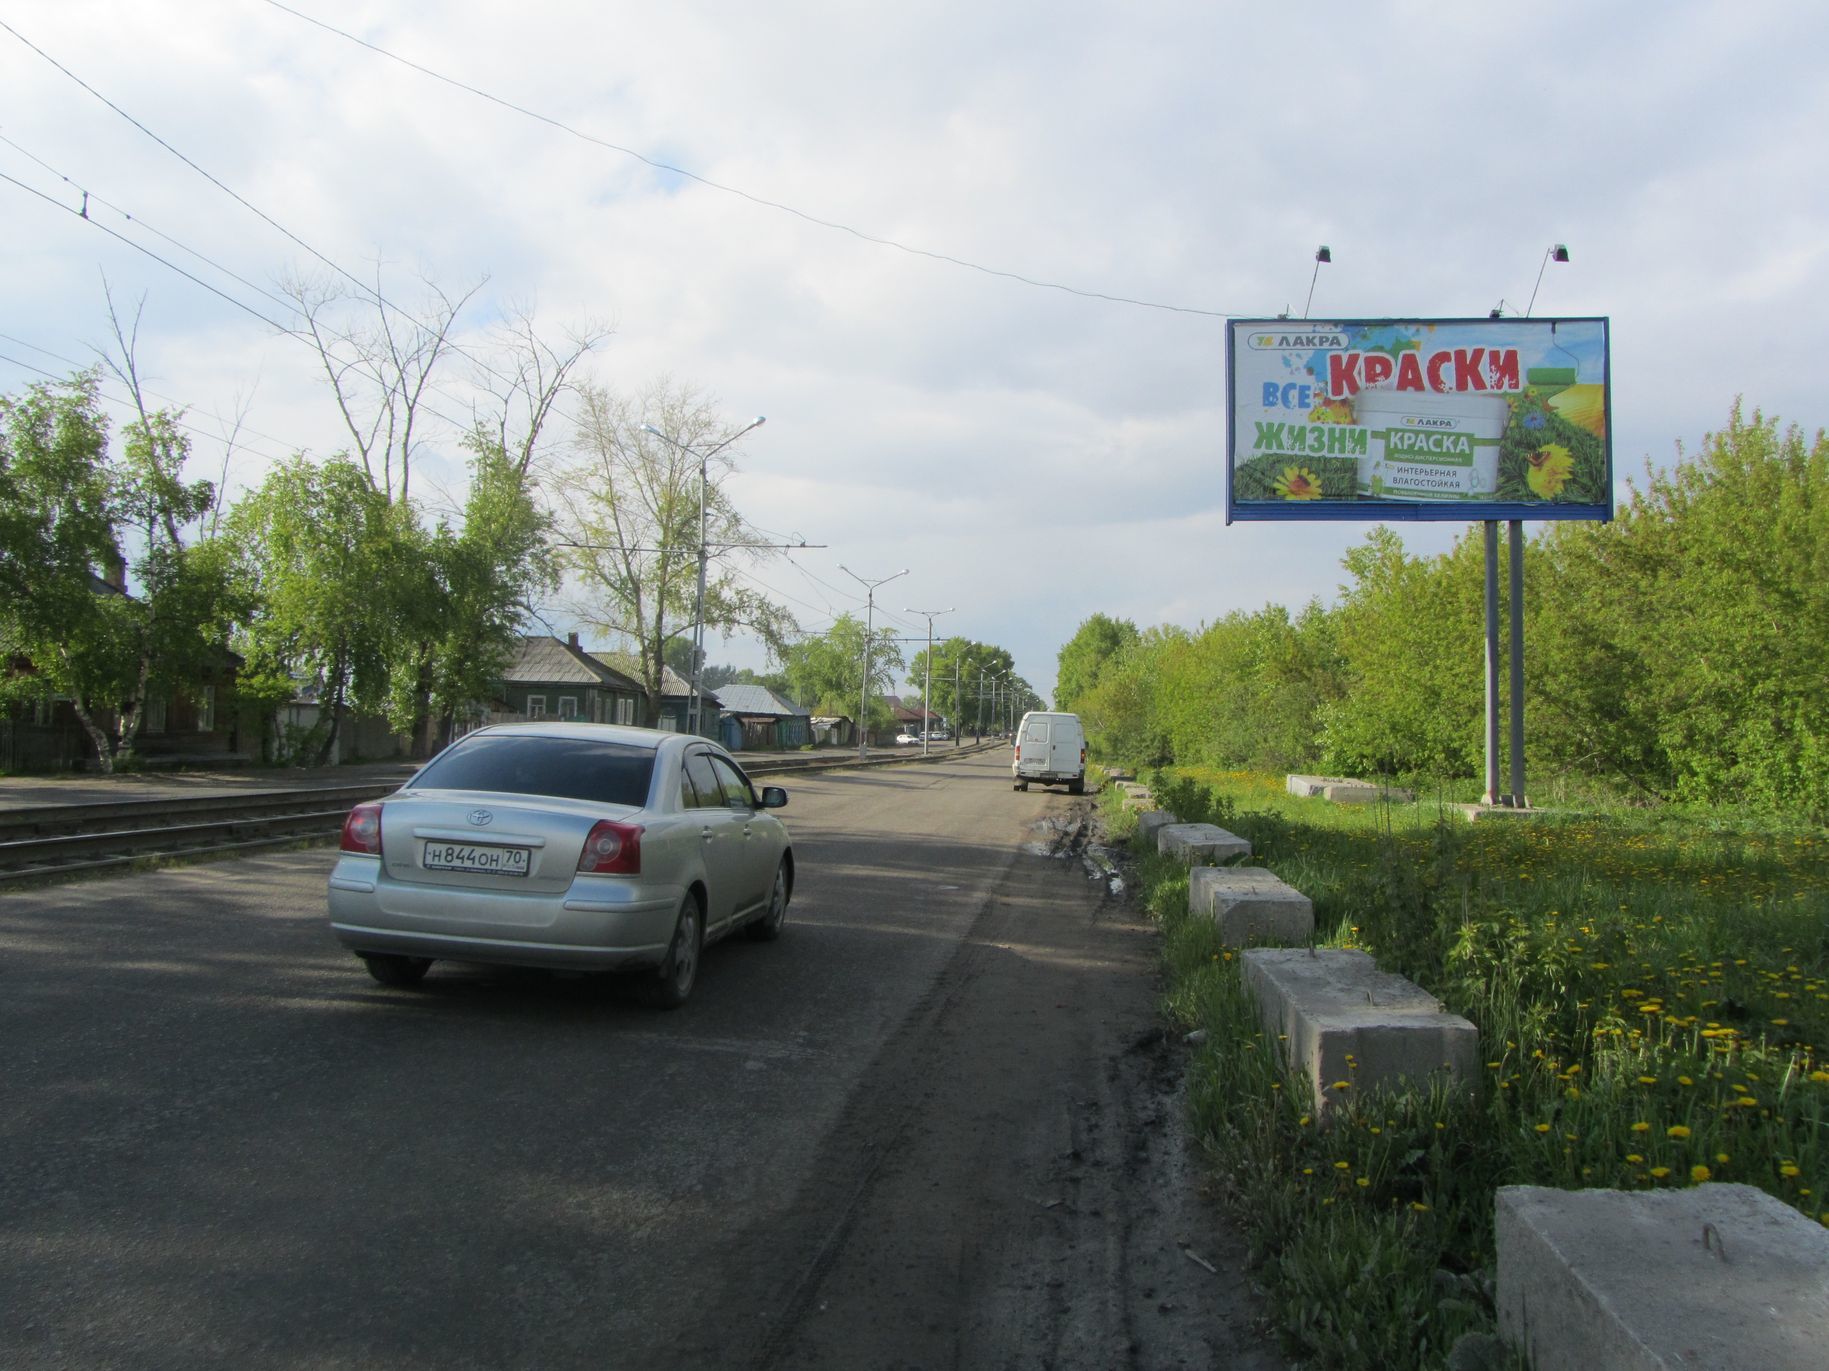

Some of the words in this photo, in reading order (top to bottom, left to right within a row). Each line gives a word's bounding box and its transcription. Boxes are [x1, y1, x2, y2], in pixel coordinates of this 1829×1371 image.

[1278, 335, 1341, 347] ЛАКРА
[1329, 347, 1520, 397] КРАСКИ
[1262, 382, 1312, 409] ВСЕ
[1417, 418, 1452, 427] ЛАКРА
[1252, 421, 1368, 455] ЖИЗНИ
[1390, 431, 1470, 454] КРАСКА
[1397, 466, 1457, 478] ИНТЕРЬЕРНАЯ
[1392, 476, 1461, 489] ВЛАГОСТОЙКАЯ
